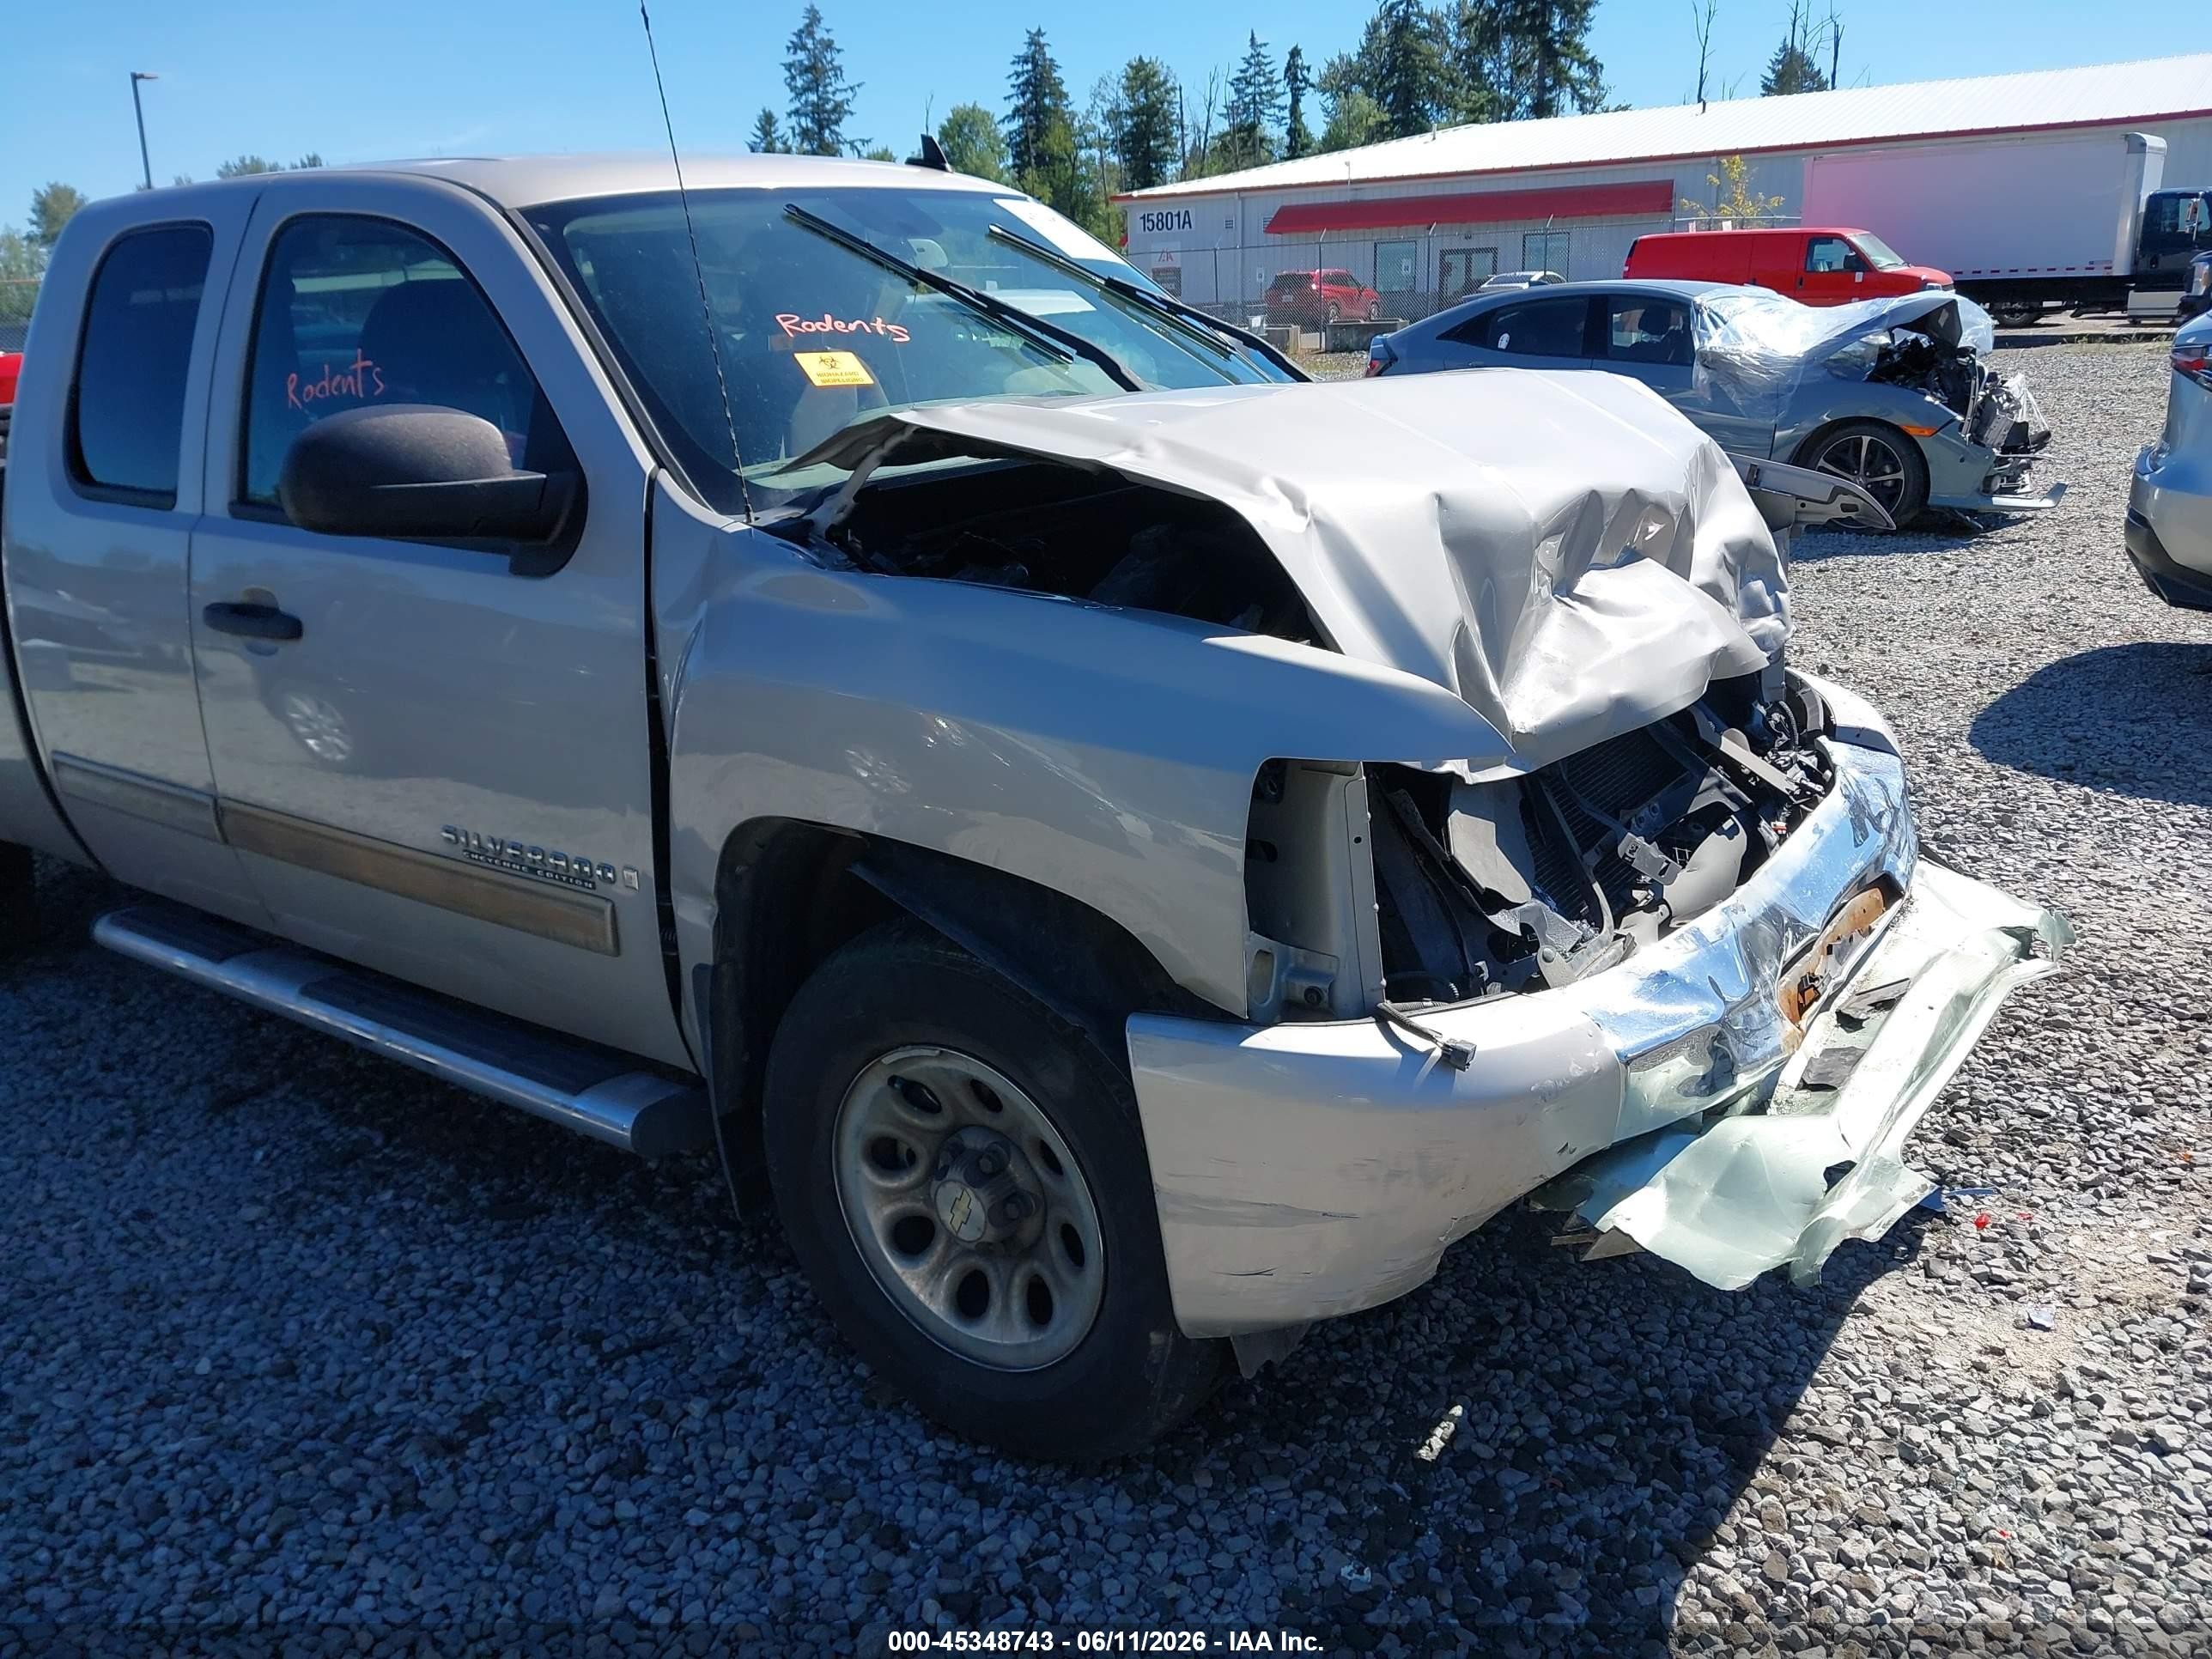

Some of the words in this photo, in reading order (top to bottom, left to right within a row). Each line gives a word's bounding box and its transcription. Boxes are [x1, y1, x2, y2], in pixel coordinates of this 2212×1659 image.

[1139, 210, 1193, 233] 15801A
[775, 313, 911, 343] Rodents
[288, 348, 385, 410] Rodents
[441, 824, 617, 884] SILVERADO
[463, 849, 529, 873] CHEYENNE
[537, 869, 592, 890] EDITION
